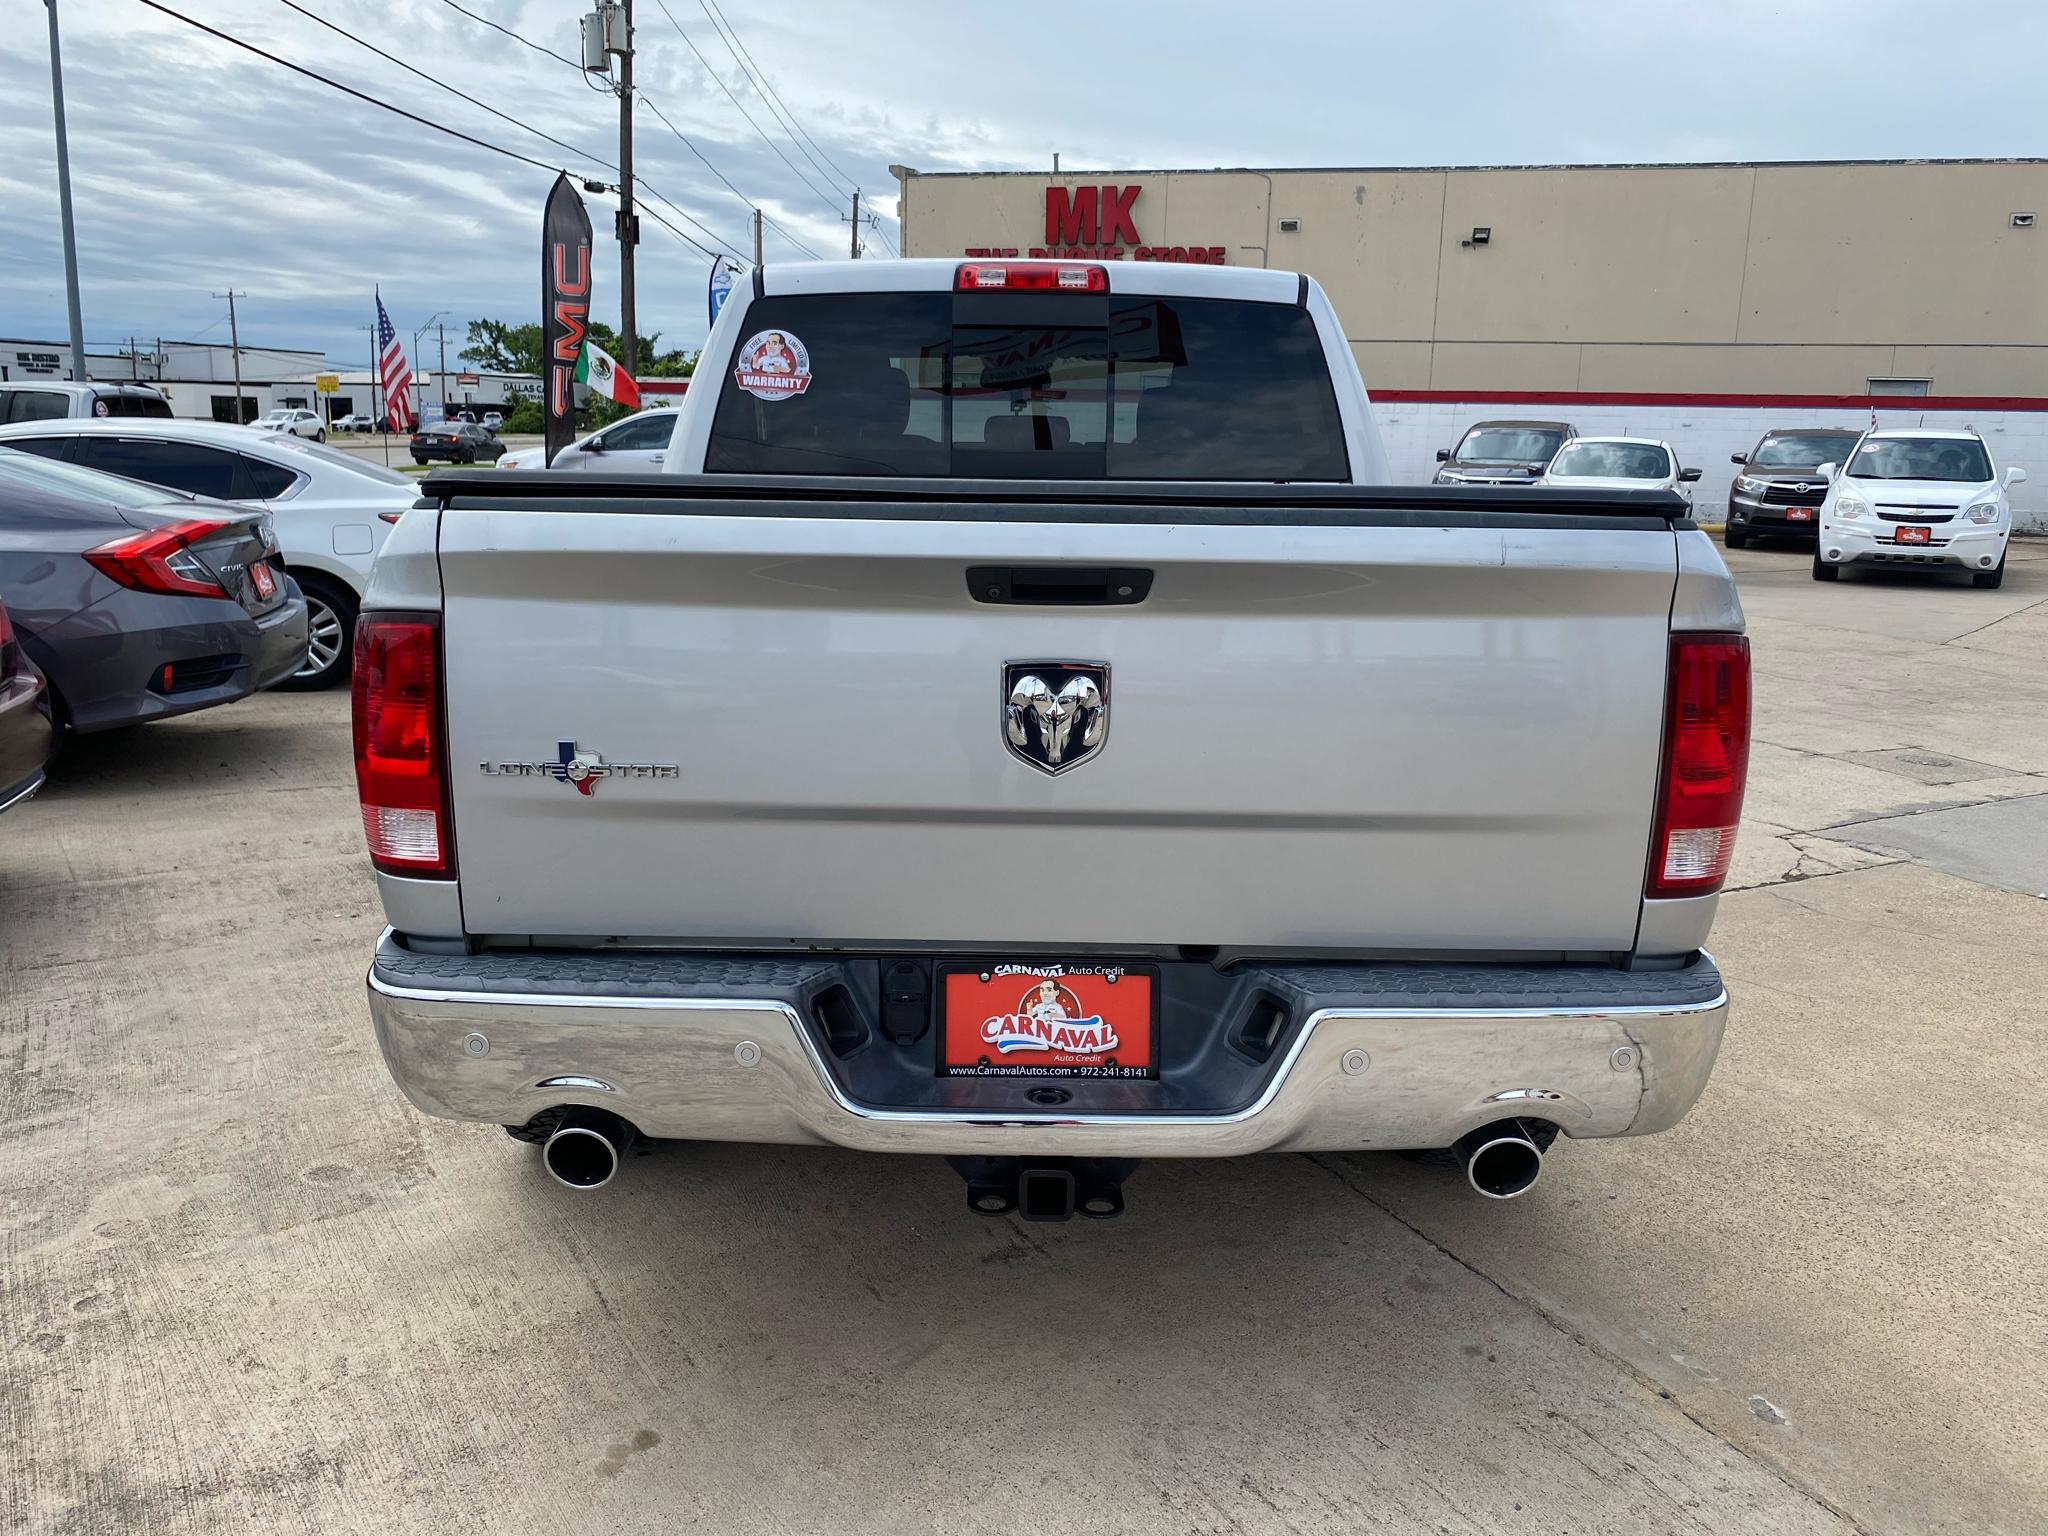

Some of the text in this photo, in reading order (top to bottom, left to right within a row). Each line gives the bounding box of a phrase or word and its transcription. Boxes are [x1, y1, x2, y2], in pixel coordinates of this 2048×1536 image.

[1045, 186, 1142, 245] MK
[788, 338, 804, 359] LIMITED
[503, 383, 535, 392] DALLAS
[742, 375, 802, 388] WARRANTY
[220, 563, 244, 572] CIVIC
[480, 761, 679, 778] LONE STAR
[994, 964, 1125, 977] CARNAVAL Auto Credit
[981, 1014, 1117, 1051] CARNAVAL
[1053, 1054, 1101, 1062] Auto Credit
[949, 1066, 1147, 1077] www.CarnavalAutos.com 972-241-8141
